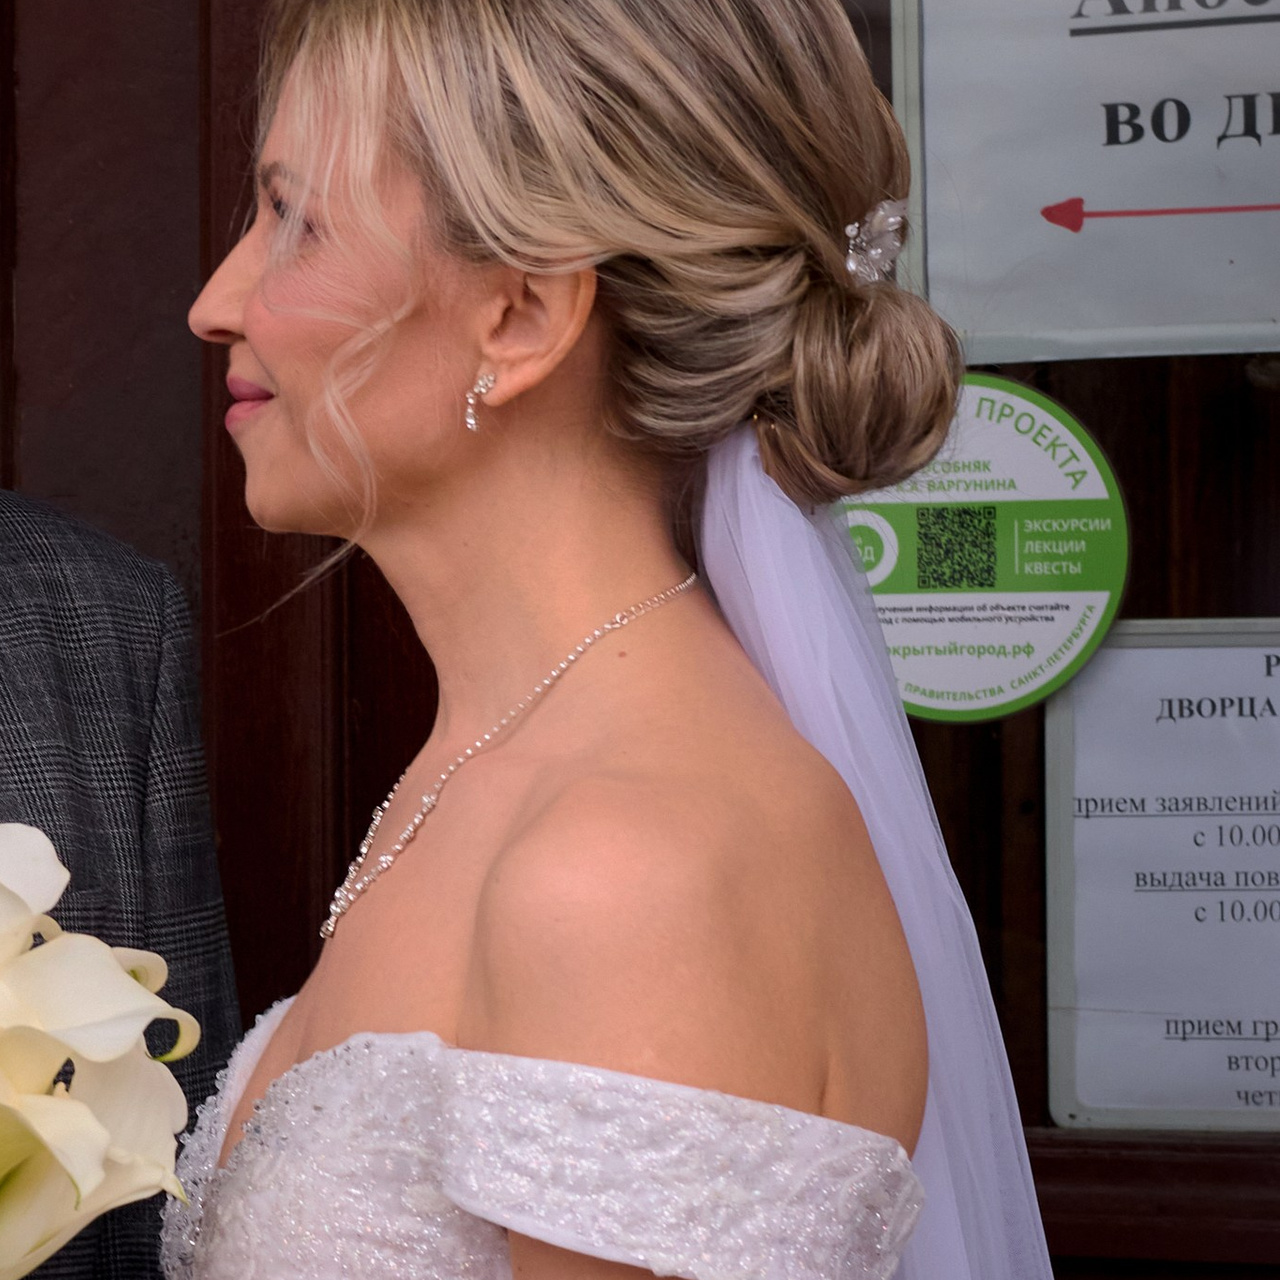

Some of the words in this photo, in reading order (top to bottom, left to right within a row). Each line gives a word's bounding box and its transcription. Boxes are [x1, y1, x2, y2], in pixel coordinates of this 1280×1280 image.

[1101, 97, 1191, 147] во
[975, 397, 1088, 490] ПРОЕКТА
[927, 478, 1017, 492] ВАРГУНИНА
[1023, 518, 1112, 533] ЭКСКУРСИИ
[1023, 540, 1086, 555] ЛЕКЦИИ
[1023, 561, 1081, 575] КВЕСТЫ
[976, 604, 987, 612] об
[904, 682, 1005, 701] ПРАВИТЕЛЬСТВА
[1010, 604, 1096, 690] САНКТ-ПЕТЕРБУРГА
[1156, 696, 1278, 723] ДВОРЦА
[1193, 831, 1206, 847] с
[1135, 872, 1226, 891] выдача
[1235, 871, 1280, 888] пов
[1194, 906, 1207, 922] с
[1166, 1019, 1242, 1041] прием
[1228, 1055, 1280, 1077] втор
[1237, 1090, 1280, 1106] чет
